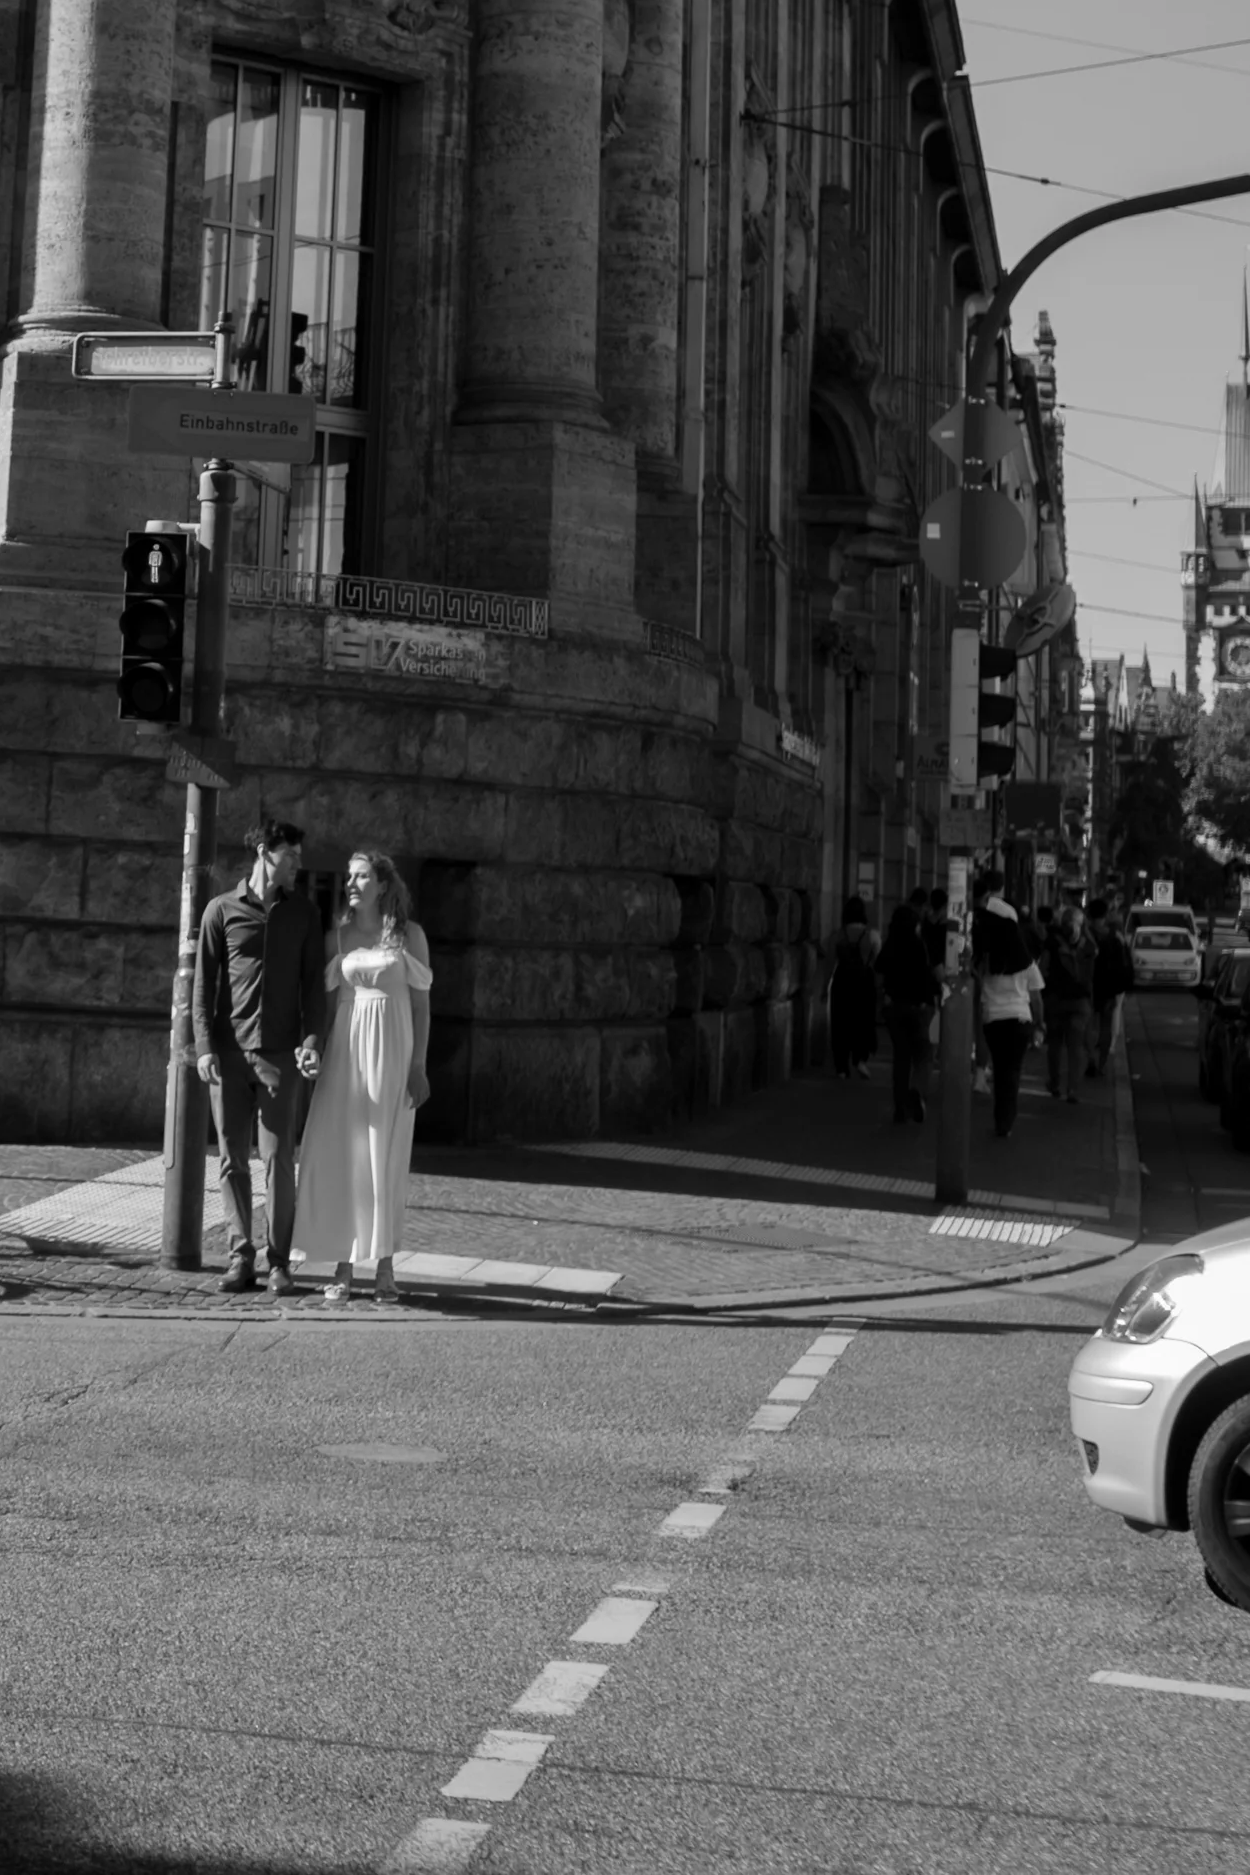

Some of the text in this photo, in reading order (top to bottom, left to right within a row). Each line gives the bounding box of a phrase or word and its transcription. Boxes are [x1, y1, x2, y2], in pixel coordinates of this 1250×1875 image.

[179, 413, 299, 436] Einbahnstraße
[408, 640, 487, 662] Sparkasn
[399, 657, 486, 684] Versicheung
